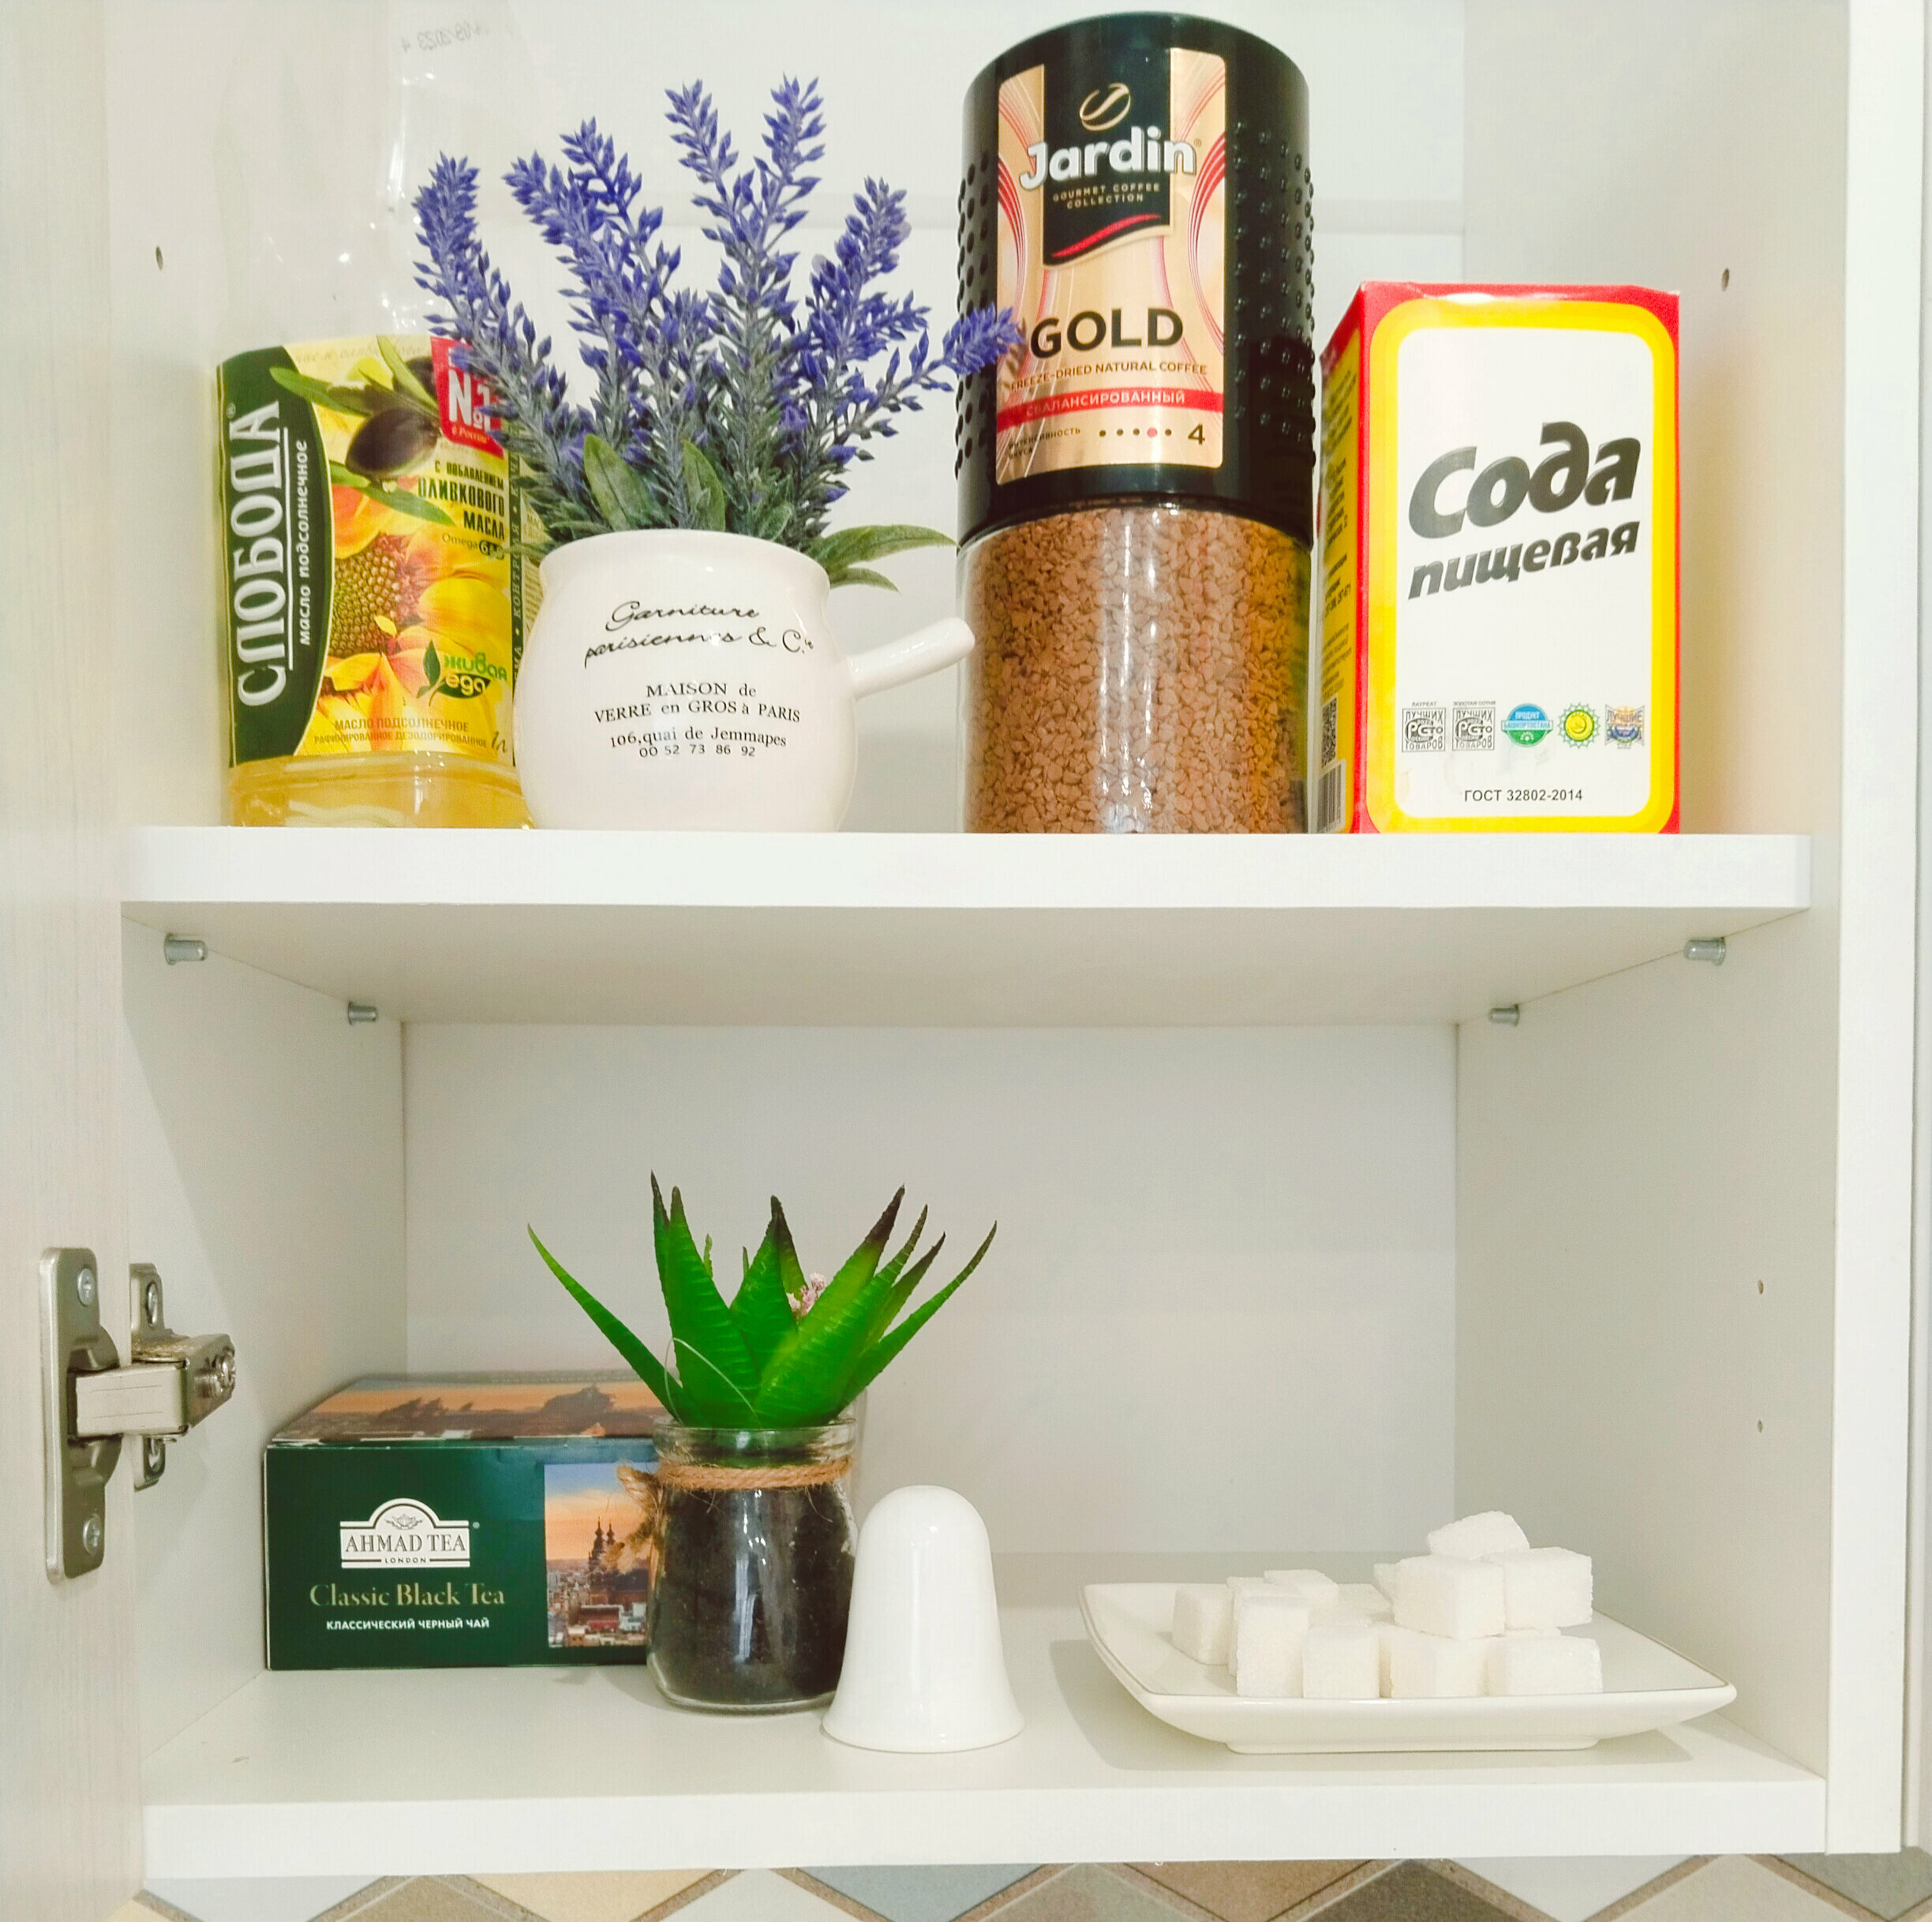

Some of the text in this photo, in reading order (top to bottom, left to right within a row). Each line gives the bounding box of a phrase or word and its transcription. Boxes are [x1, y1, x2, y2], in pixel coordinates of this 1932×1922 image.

[1019, 126, 1196, 190] Jardin
[1053, 182, 1160, 202] GOURMET COFFEE
[1066, 193, 1144, 209] COLLECTION
[1031, 308, 1184, 359] GOLD
[1095, 361, 1156, 373] NATURAL
[1159, 361, 1208, 375] COFFEE
[1187, 424, 1206, 445] 4
[435, 460, 440, 474] С
[1408, 421, 1642, 539] Сода
[417, 477, 505, 518] ОЛИВКОВОГО
[462, 510, 505, 541] МАСЛА
[296, 440, 311, 646] масло подсолнечное
[441, 534, 477, 550] Omega
[229, 400, 286, 707] СЛОБОДА
[1408, 521, 1641, 600] пищевая
[605, 601, 759, 631] Garniture
[584, 631, 742, 669] parisienns
[749, 626, 777, 647] &
[646, 682, 757, 698] MAISON de
[594, 700, 801, 724] VERRE en GROS à PARIS
[1405, 710, 1443, 724] ЛУЧШИХ
[1455, 710, 1493, 724] ЛУЧШИХ
[335, 717, 469, 732] МАСЛО ПОДСОЛНЕЧНОЕ
[314, 731, 488, 748] РАФИНИРОВАННОЕ ДЕЗОДОРИРОВАННОЕ
[684, 726, 703, 741] de
[711, 727, 788, 747] Jemmapes
[639, 744, 756, 759] 00 52 73 86 92
[1464, 789, 1583, 802] ГОСТ 32802-2014
[345, 1534, 466, 1553] AHMAD TEA
[310, 1582, 505, 1606] Classic Black Tea
[326, 1617, 490, 1630] КЛАССИЧЕСКИЙ ЧЕРНЫЙ ЧАЙ
